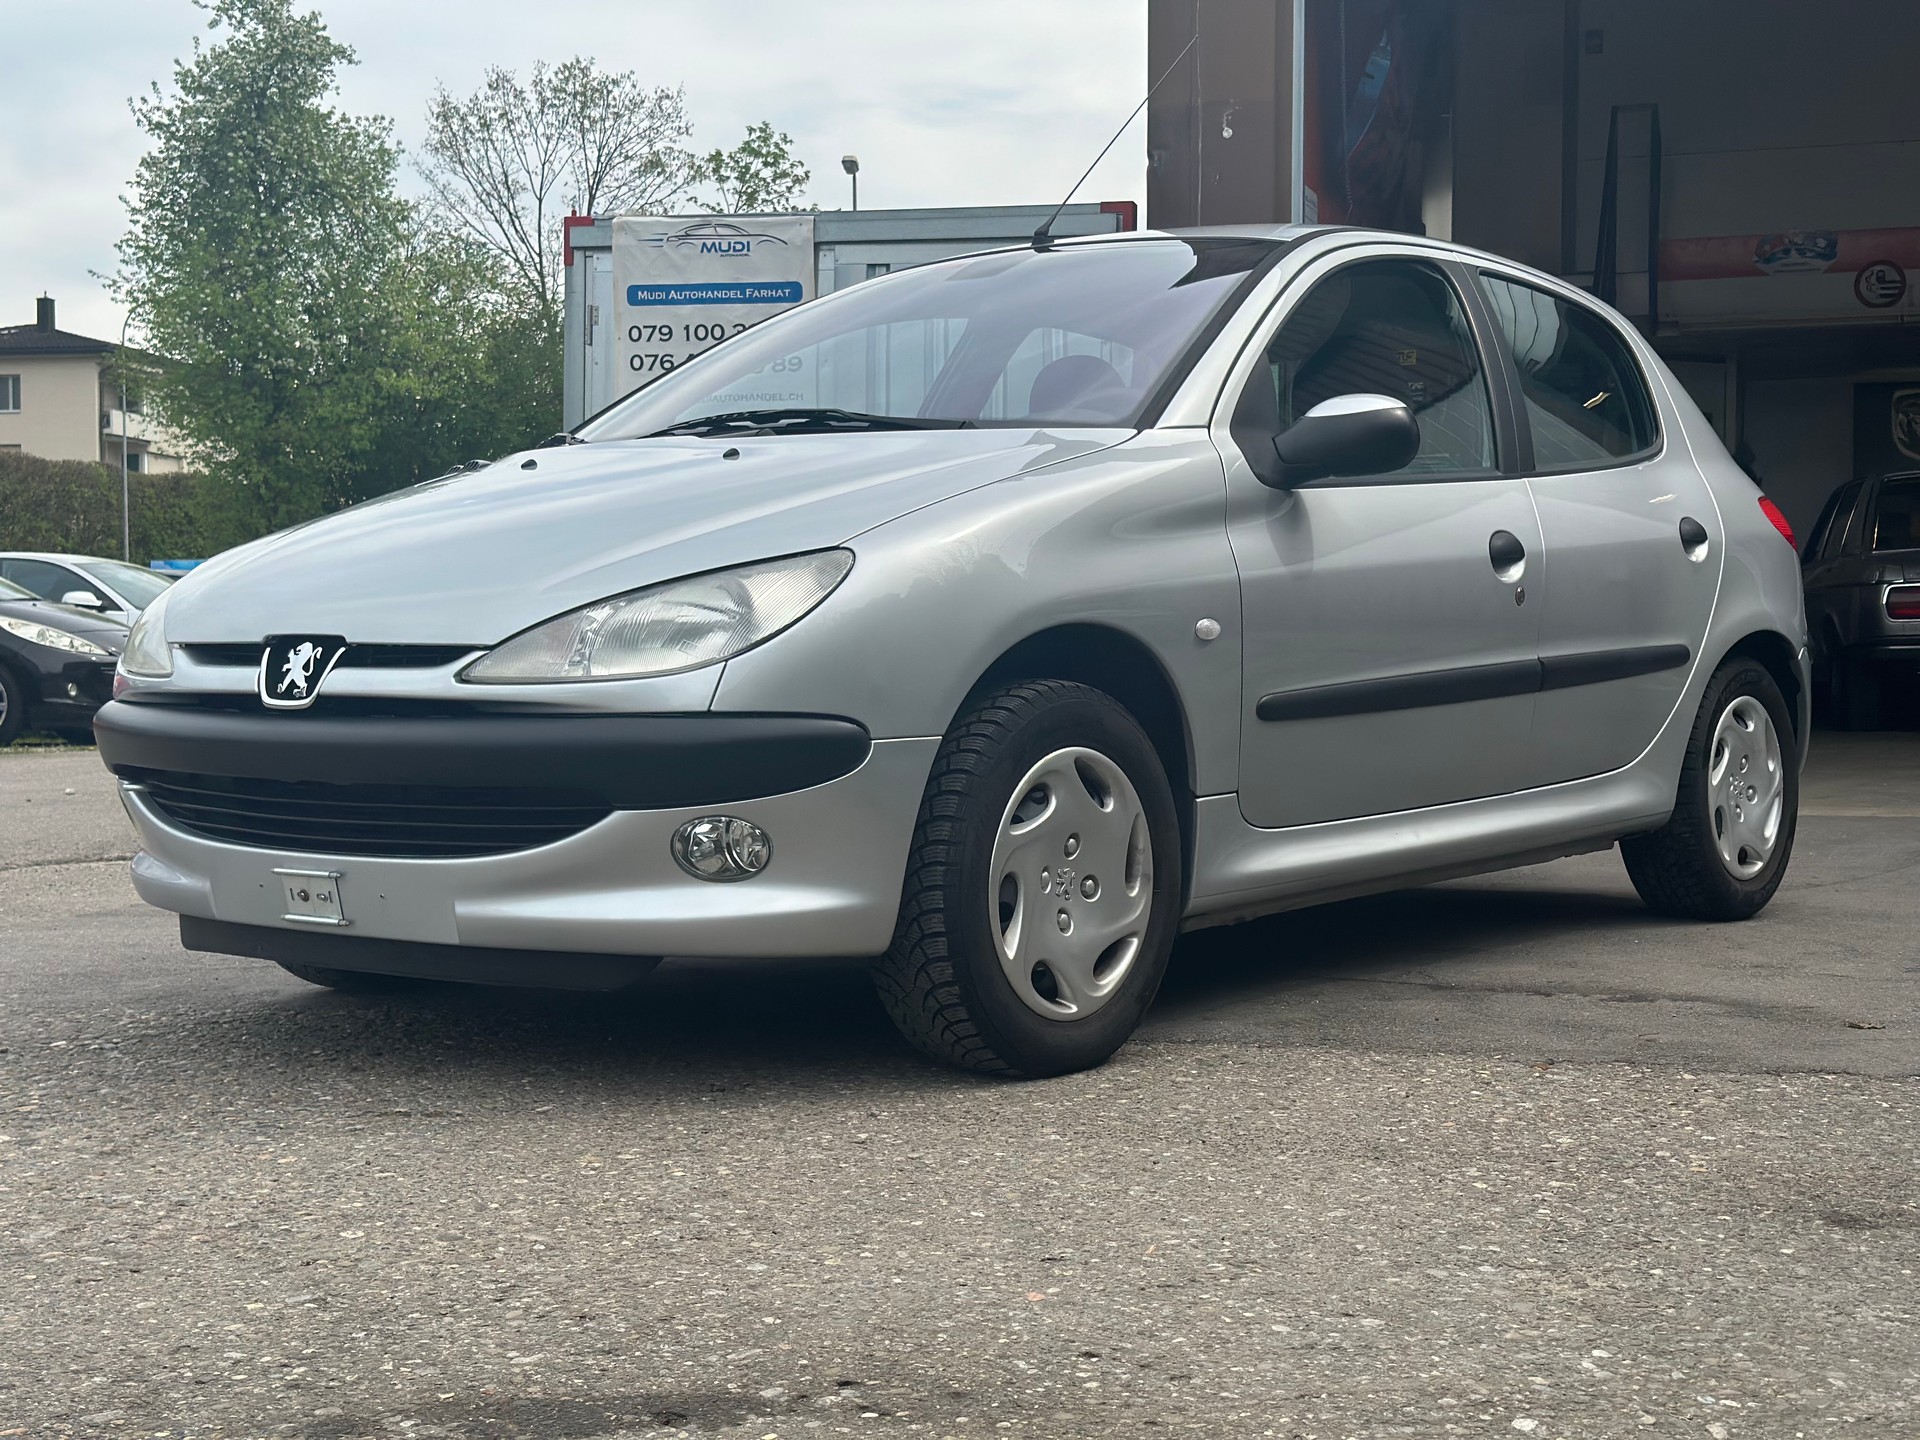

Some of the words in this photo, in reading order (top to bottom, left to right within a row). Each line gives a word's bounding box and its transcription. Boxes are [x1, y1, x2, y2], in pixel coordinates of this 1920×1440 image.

[700, 241, 750, 253] MUDI
[638, 291, 666, 300] MUDI
[669, 289, 743, 299] AUTOHANDEL
[746, 288, 790, 298] FARHAT
[628, 324, 673, 342] 079
[684, 323, 725, 341] 100
[629, 353, 675, 371] 076
